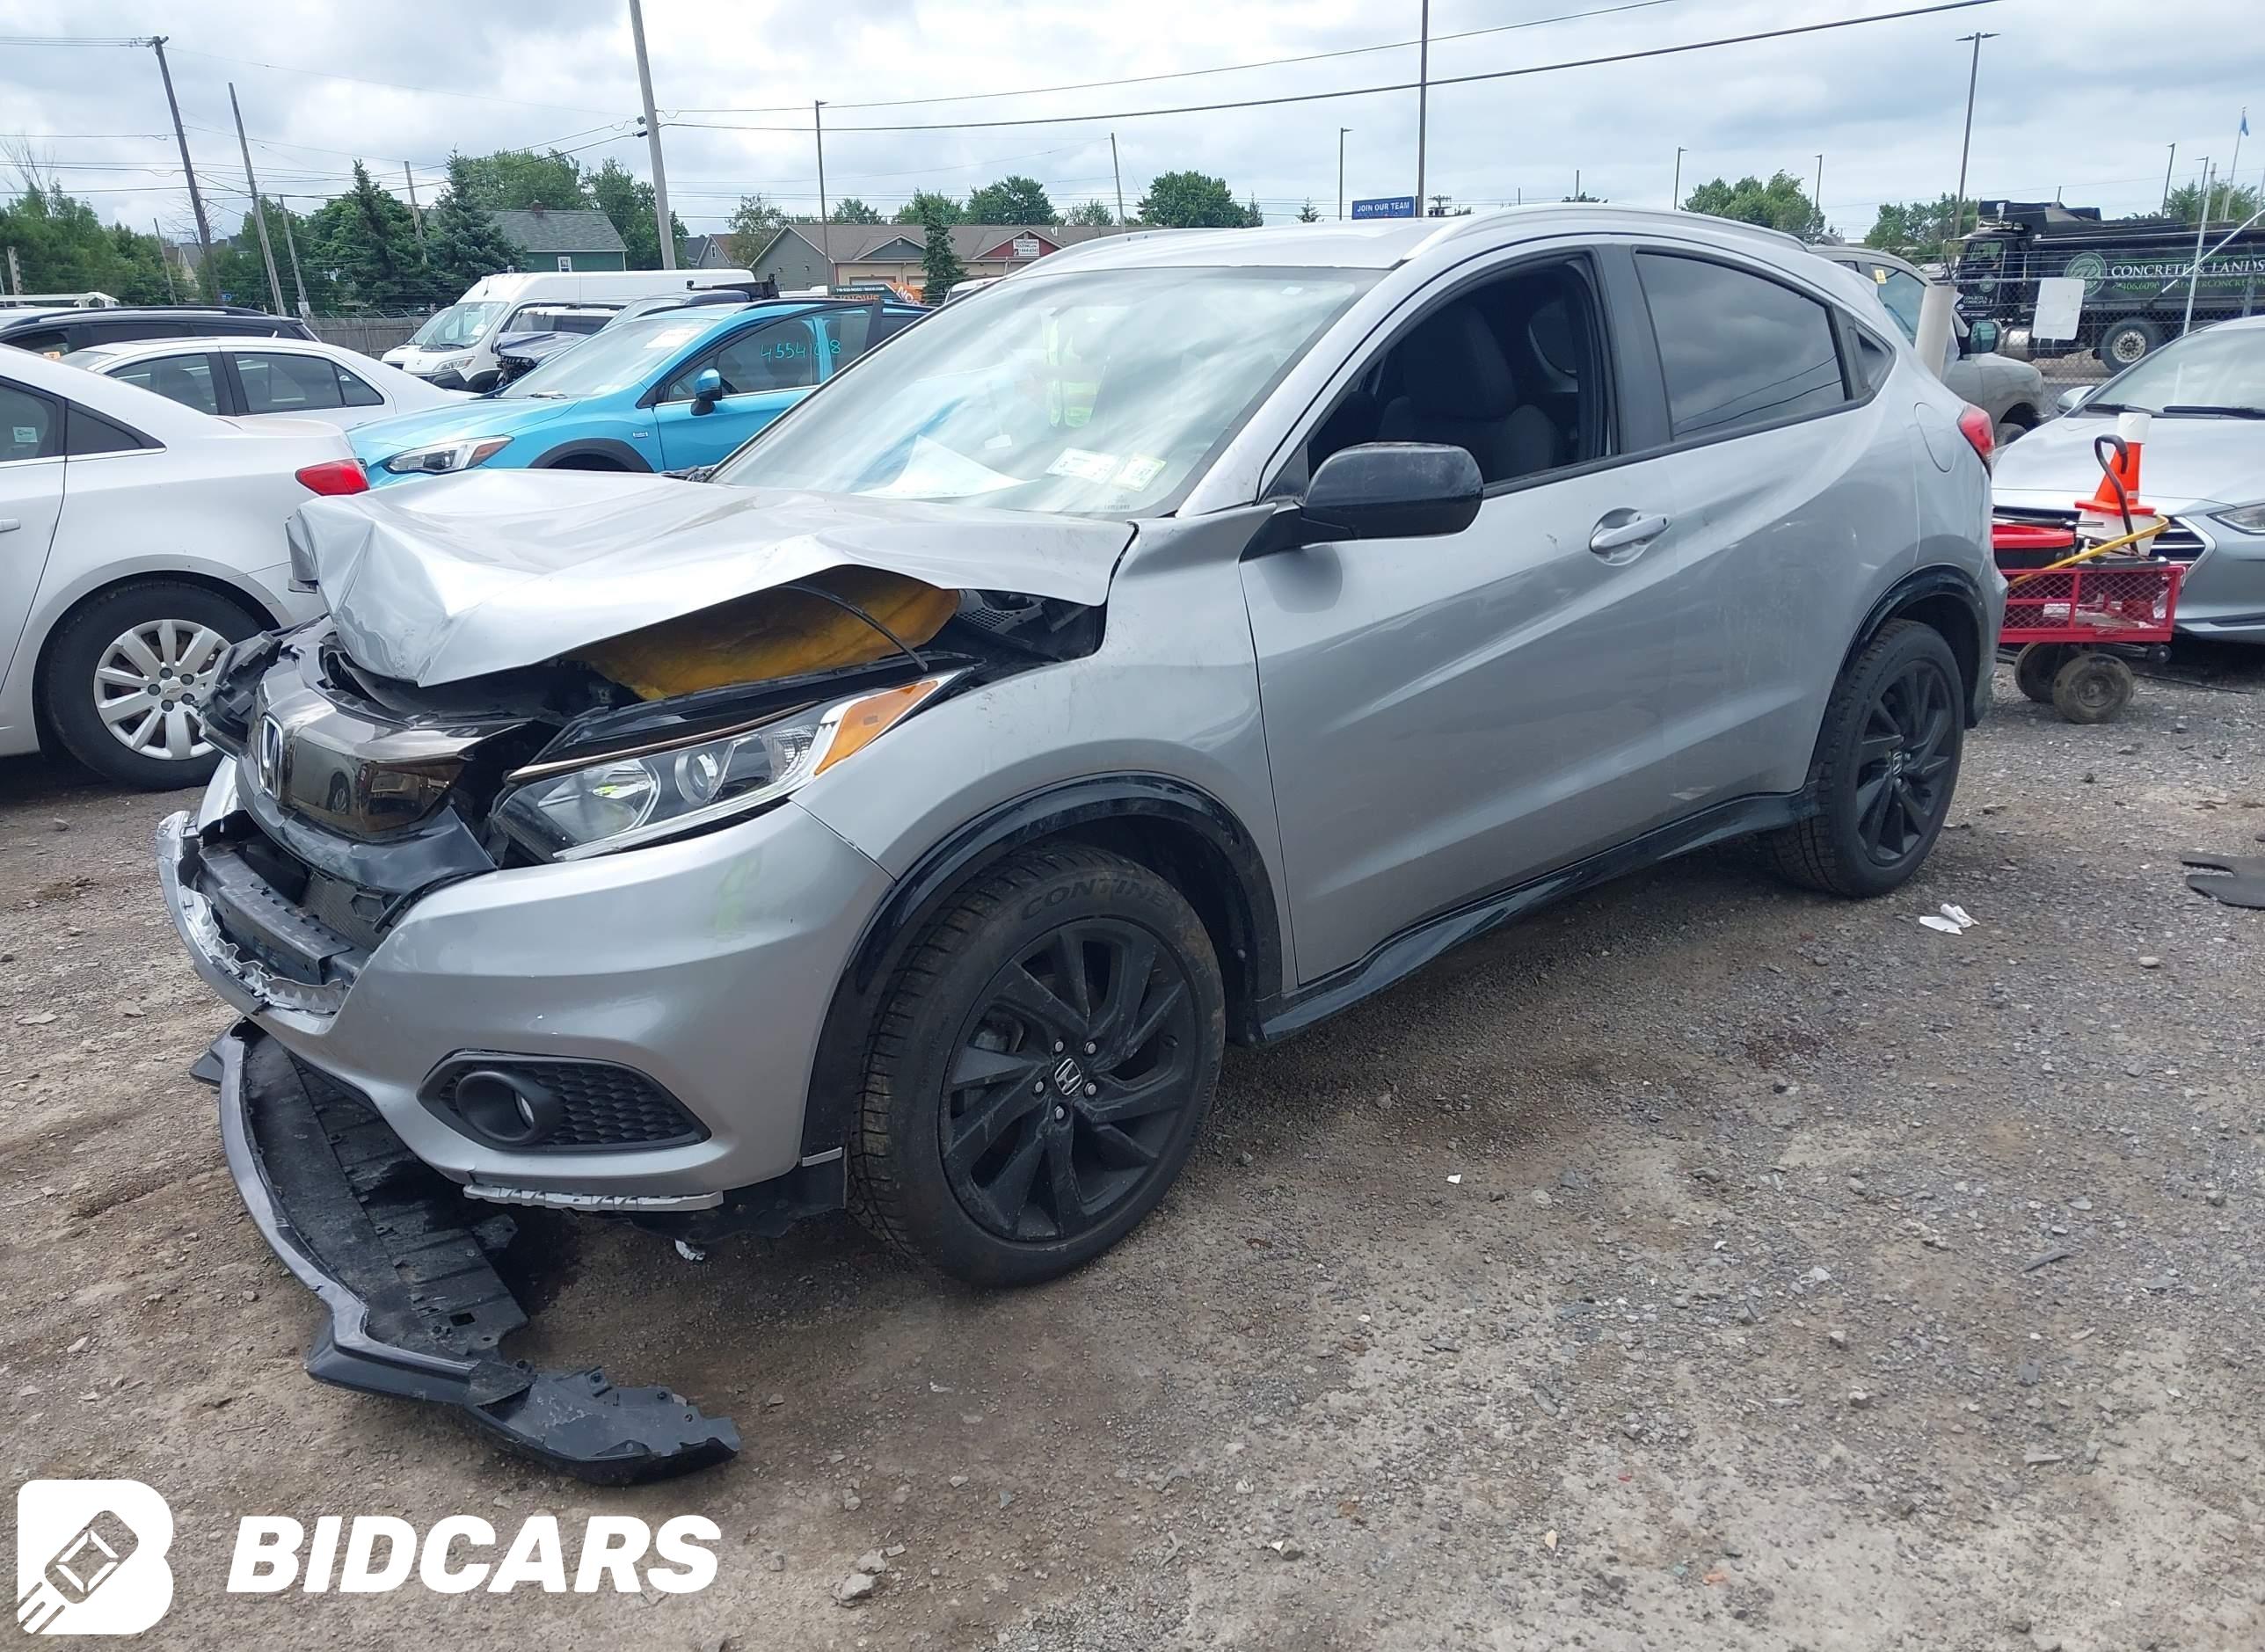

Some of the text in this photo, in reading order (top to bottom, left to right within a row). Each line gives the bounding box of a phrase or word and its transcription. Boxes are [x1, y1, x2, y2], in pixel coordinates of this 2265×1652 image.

[1357, 204, 1373, 213] JOIN
[1391, 201, 1410, 210] TEAM
[2111, 264, 2191, 277] CONCRETE
